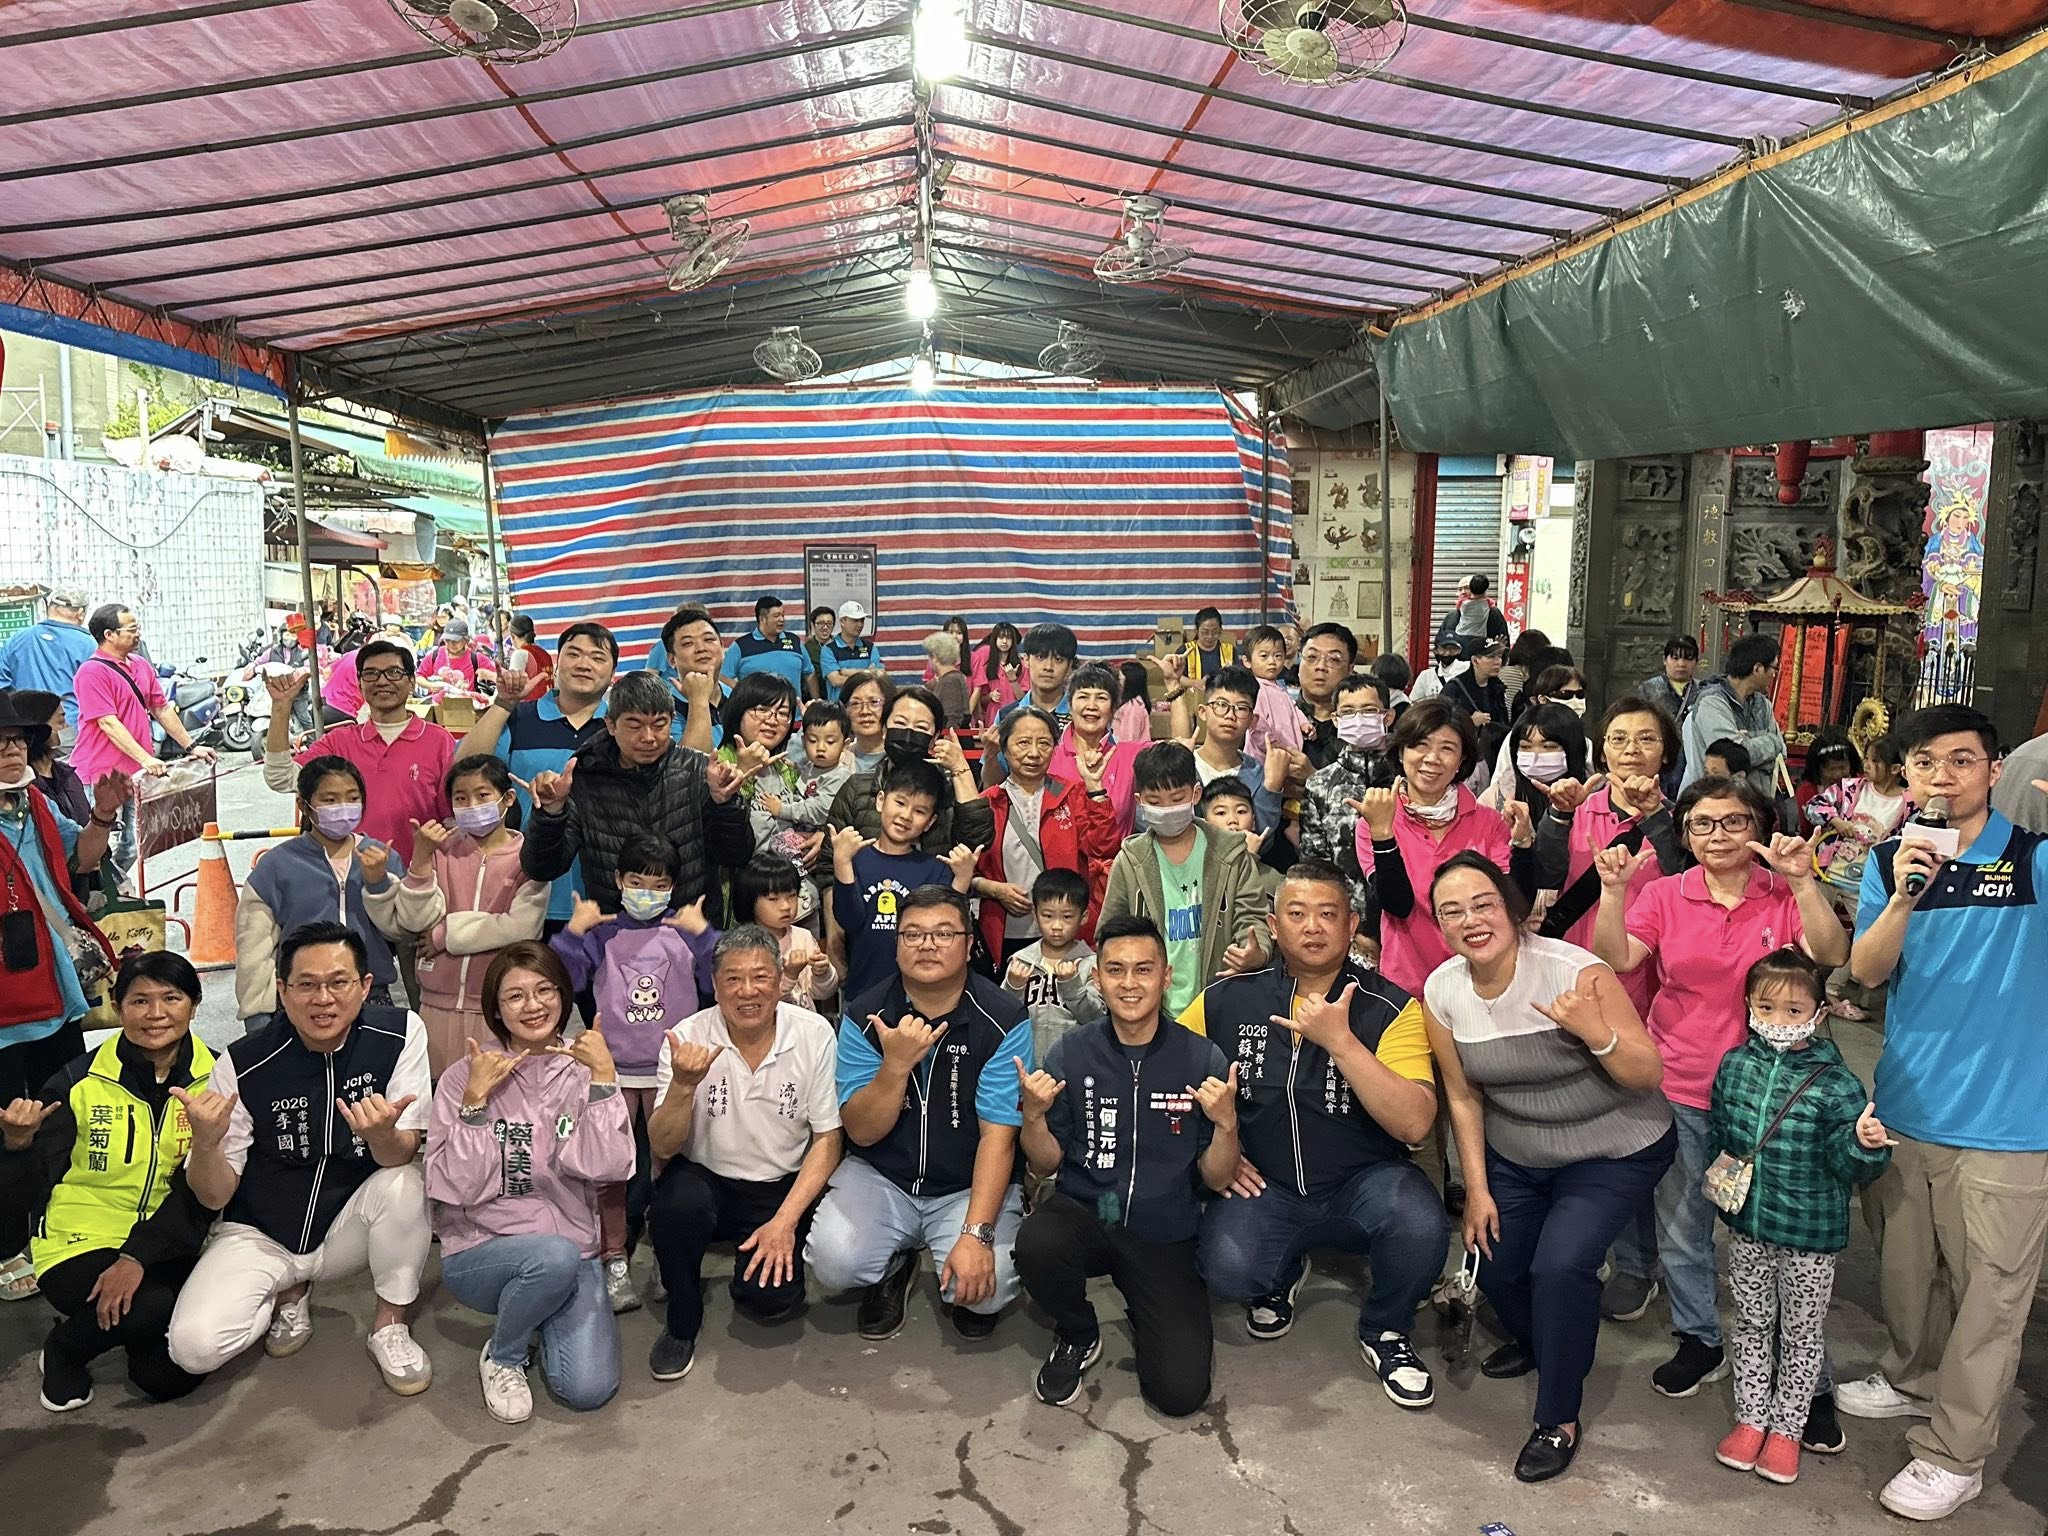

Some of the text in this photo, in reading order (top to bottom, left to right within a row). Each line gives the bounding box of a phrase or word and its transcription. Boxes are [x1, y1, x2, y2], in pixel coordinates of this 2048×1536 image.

[1972, 883, 2005, 898] JCI
[1238, 1024, 1268, 1038] 2026
[1254, 1039, 1267, 1079] 財務長
[343, 1075, 362, 1090] JCI
[271, 1096, 309, 1112] 2026
[88, 1104, 113, 1172] 葉菊蘭
[275, 1112, 294, 1160] 李國
[297, 1110, 310, 1159] 常務監事
[1096, 1107, 1118, 1169] 何元楷
